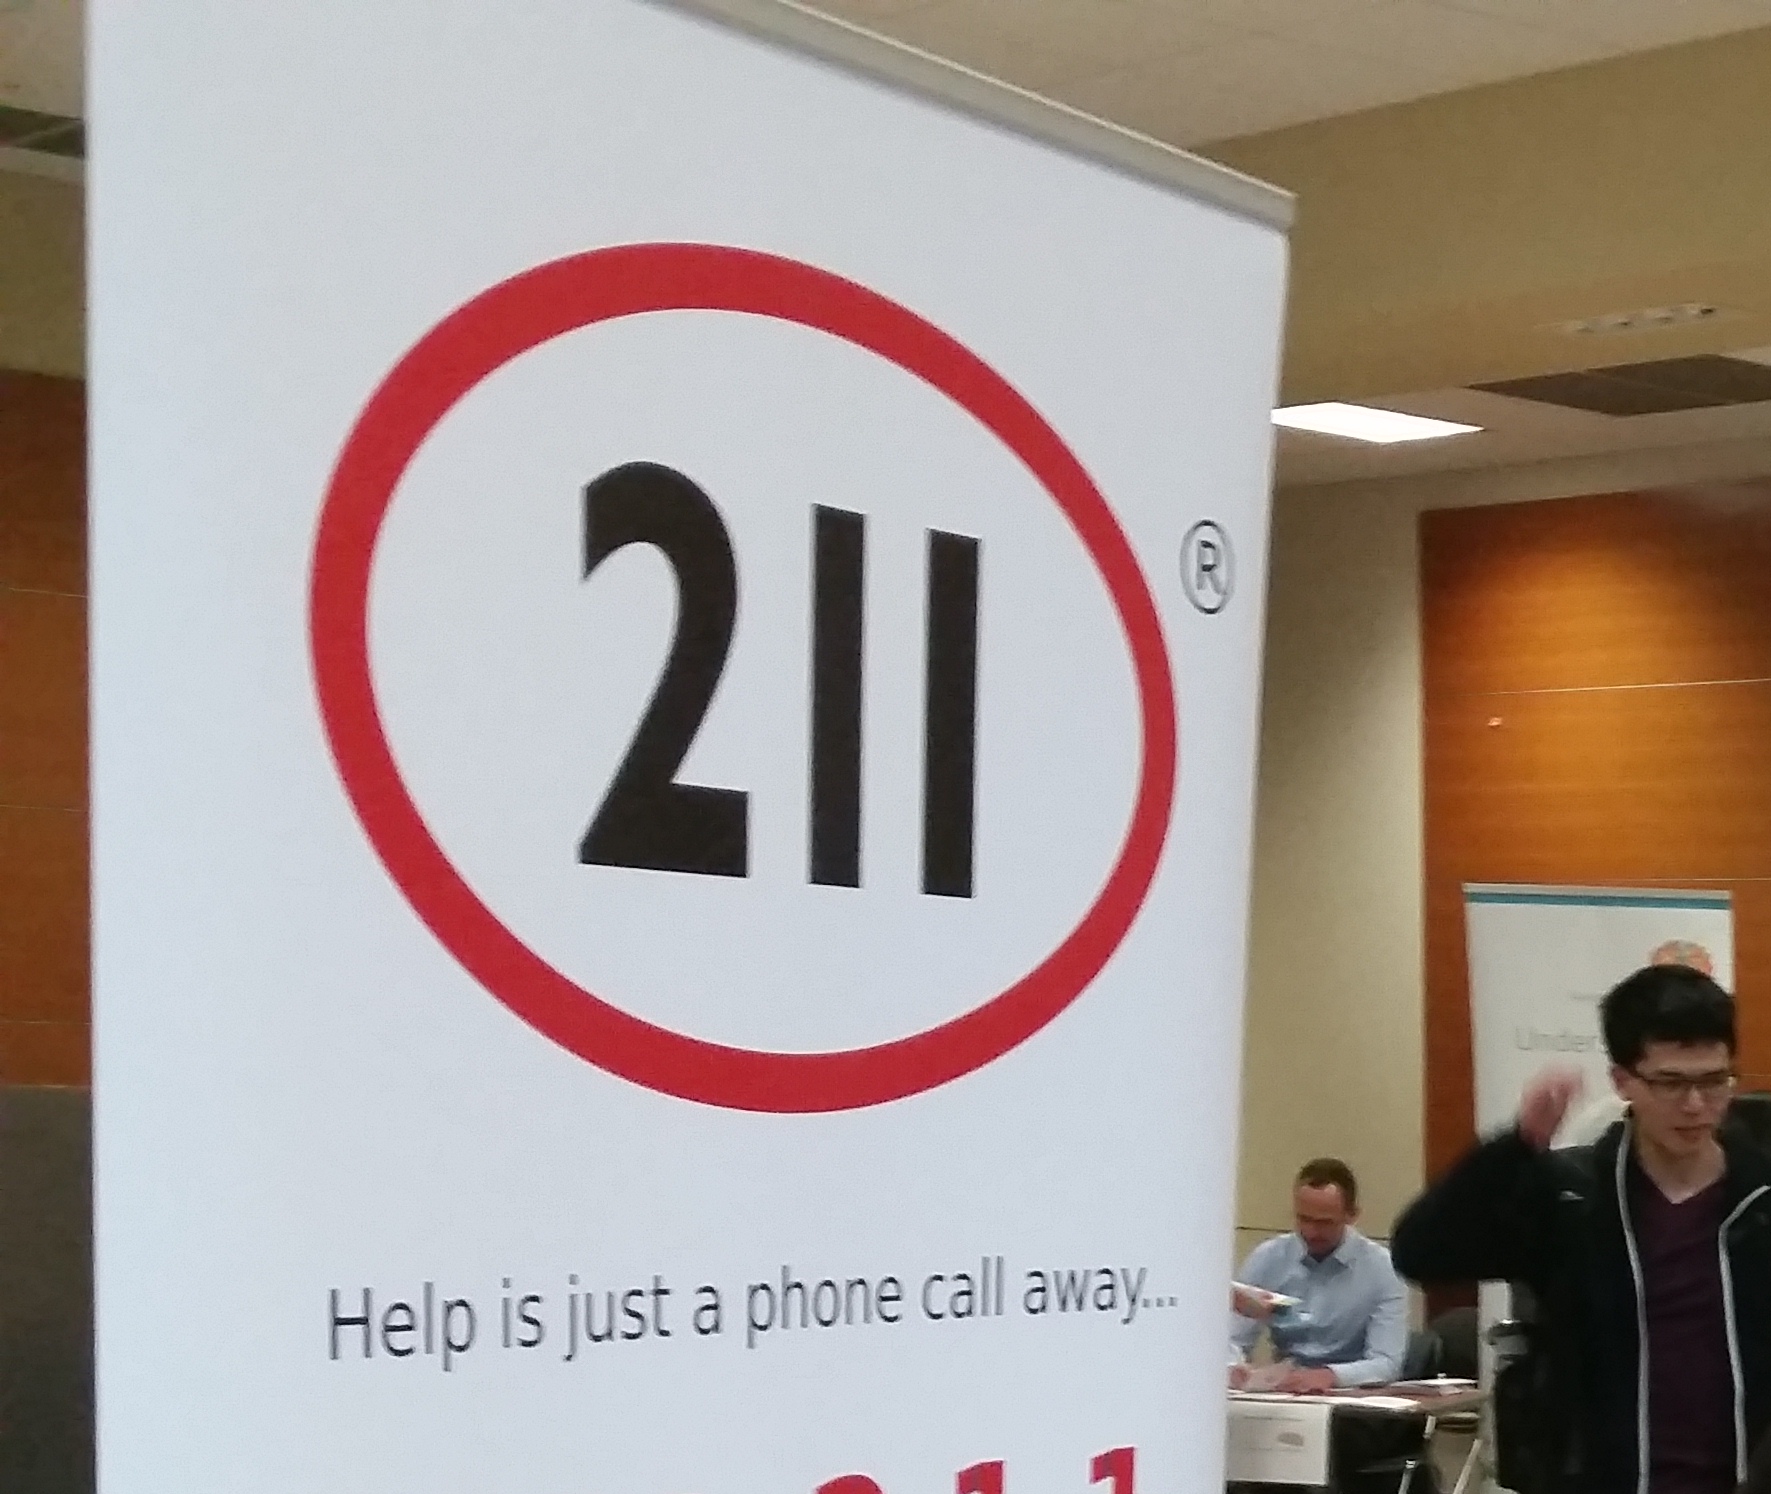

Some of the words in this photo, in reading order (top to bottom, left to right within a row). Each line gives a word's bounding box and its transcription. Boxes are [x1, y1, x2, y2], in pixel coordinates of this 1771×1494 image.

[577, 460, 981, 899] 211
[328, 1283, 477, 1372] Help
[501, 1278, 545, 1349] is
[563, 1272, 673, 1361] just
[693, 1284, 722, 1337] a
[746, 1265, 905, 1348] phone
[922, 1256, 1005, 1322] call
[1023, 1266, 1179, 1327] away...
